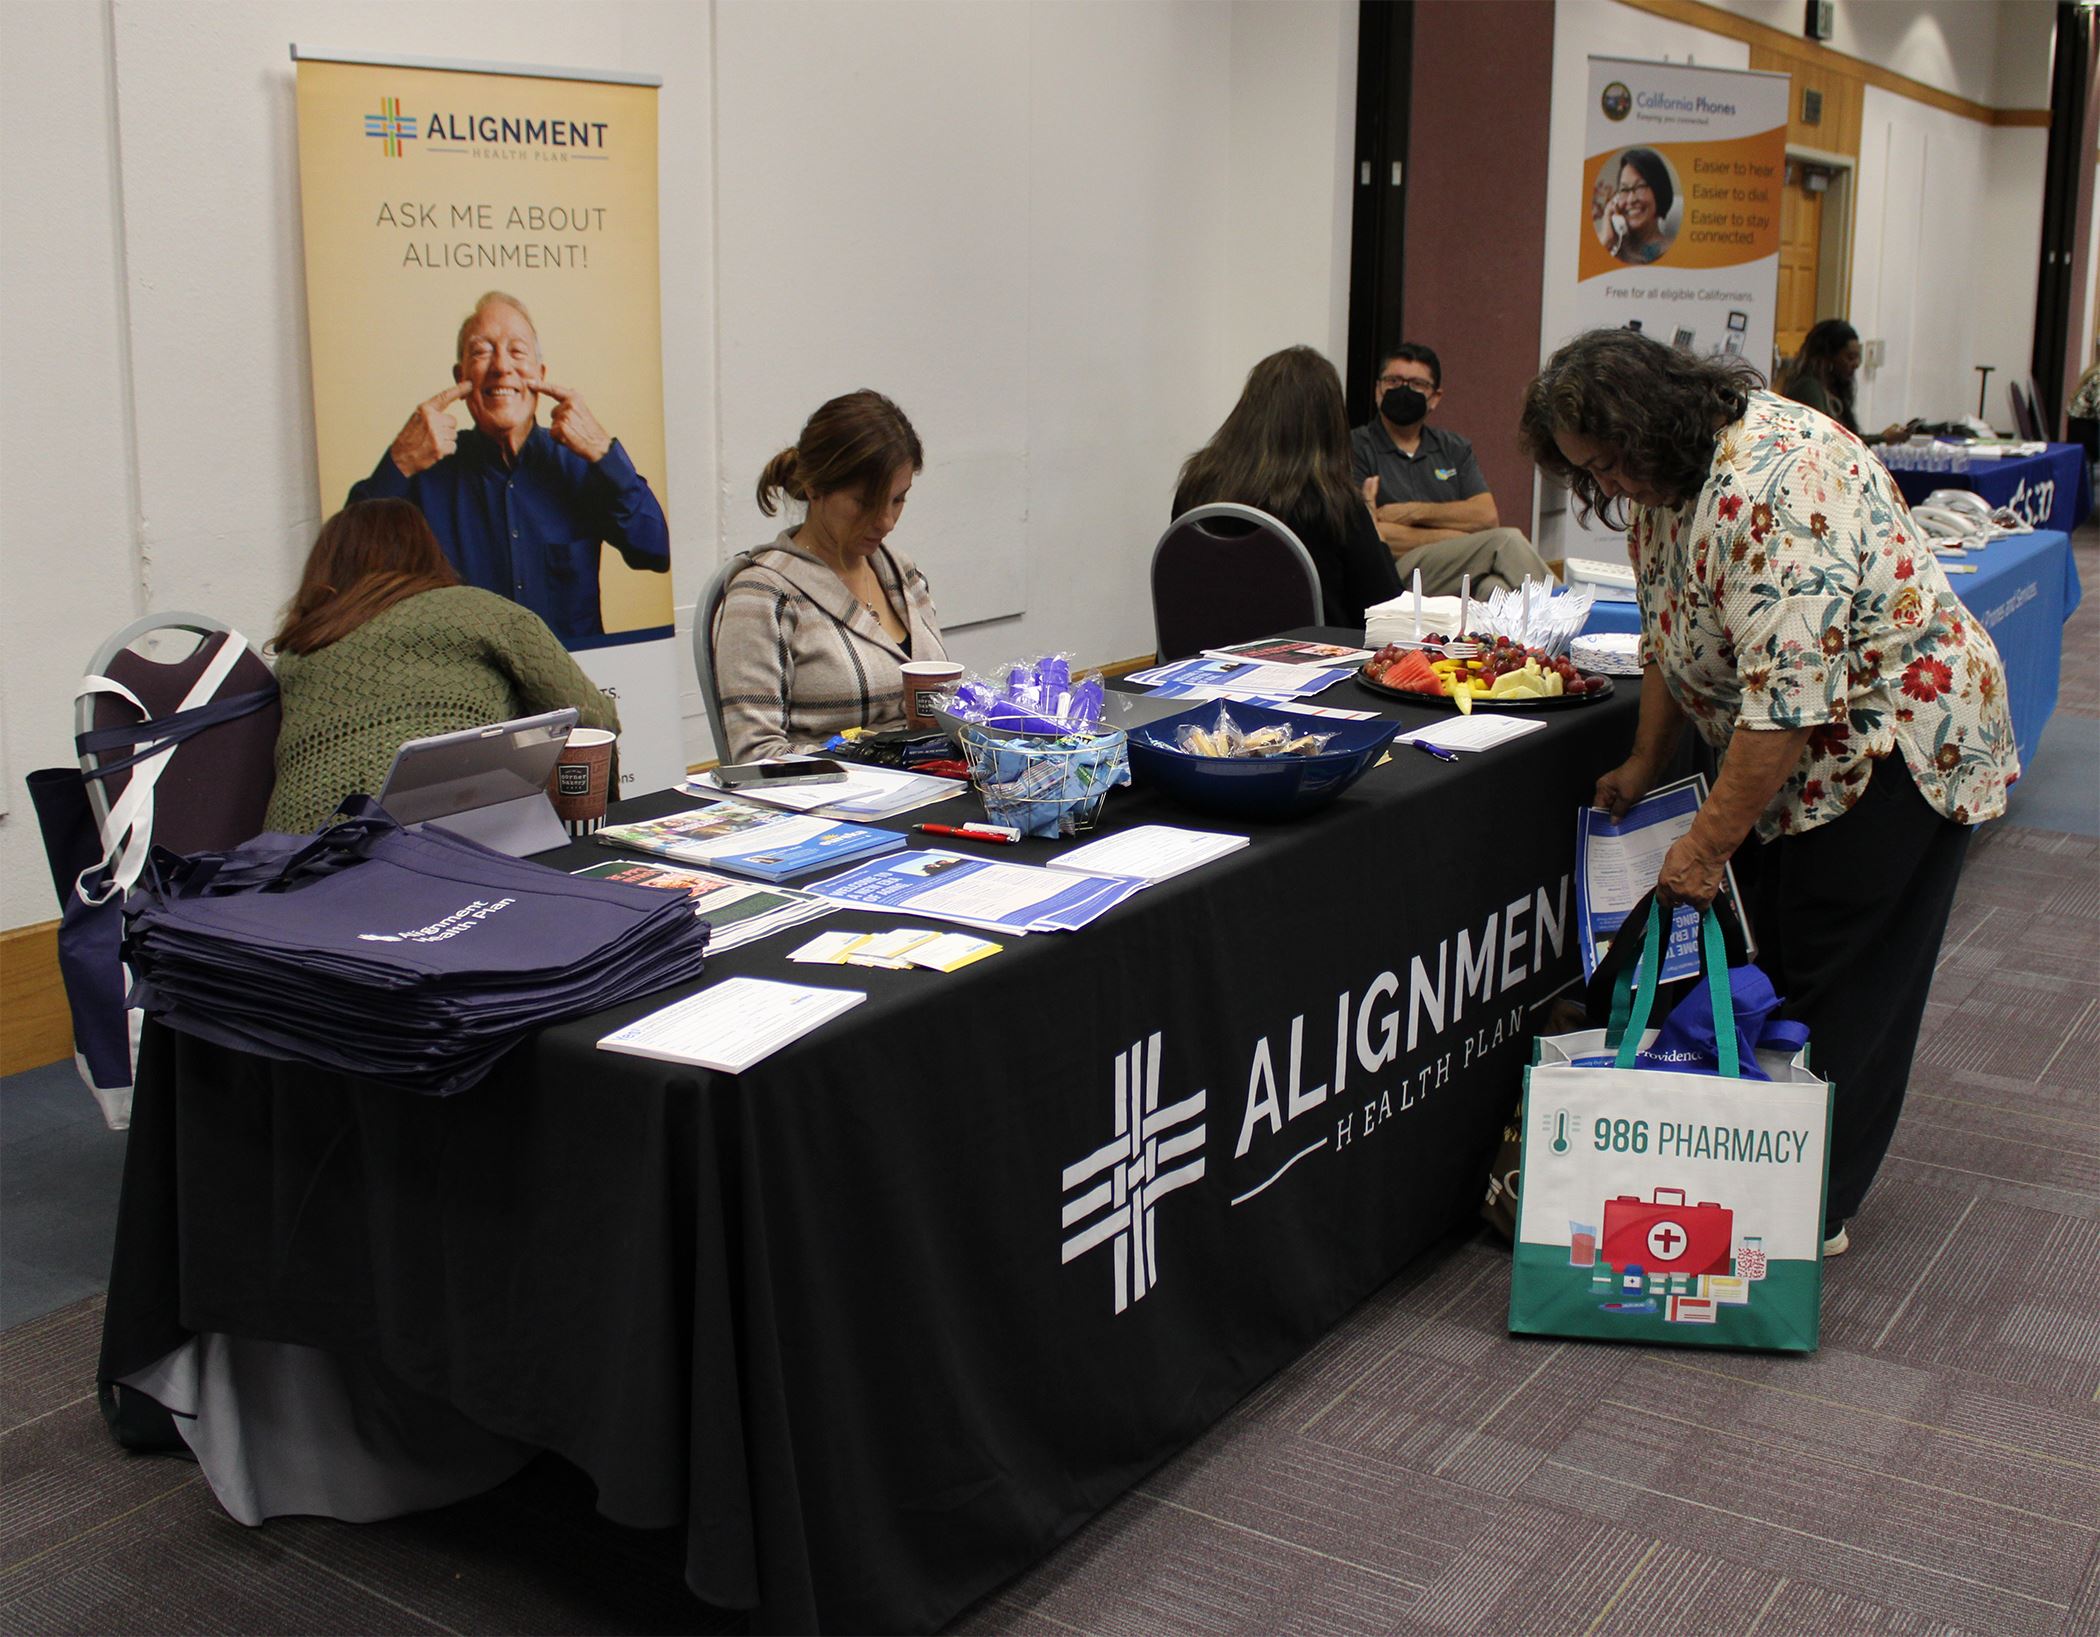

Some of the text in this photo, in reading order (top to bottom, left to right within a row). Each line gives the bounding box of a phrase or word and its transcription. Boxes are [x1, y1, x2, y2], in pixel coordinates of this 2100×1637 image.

[1637, 91, 1736, 115] California Phones
[427, 113, 608, 149] ALIGNMENT
[472, 148, 569, 162] HEALTH PLAN
[1694, 158, 1729, 174] Easier
[1734, 162, 1747, 176] to
[1693, 183, 1728, 200] Easier
[1733, 188, 1745, 201] to
[376, 202, 607, 232] ASK ME ABOUT
[1691, 209, 1770, 231] Easier to stay
[402, 243, 588, 268] ALIGNMENT!
[1606, 287, 1628, 298] Free
[1631, 287, 1644, 299] for
[1648, 288, 1659, 299] all
[1660, 288, 1695, 302] eligible
[398, 899, 488, 940] Alignment
[412, 897, 516, 943] Health Plan
[1336, 1005, 1524, 1152] HEALTH PLAN
[1594, 1117, 1809, 1165] 986 PHARMACY
